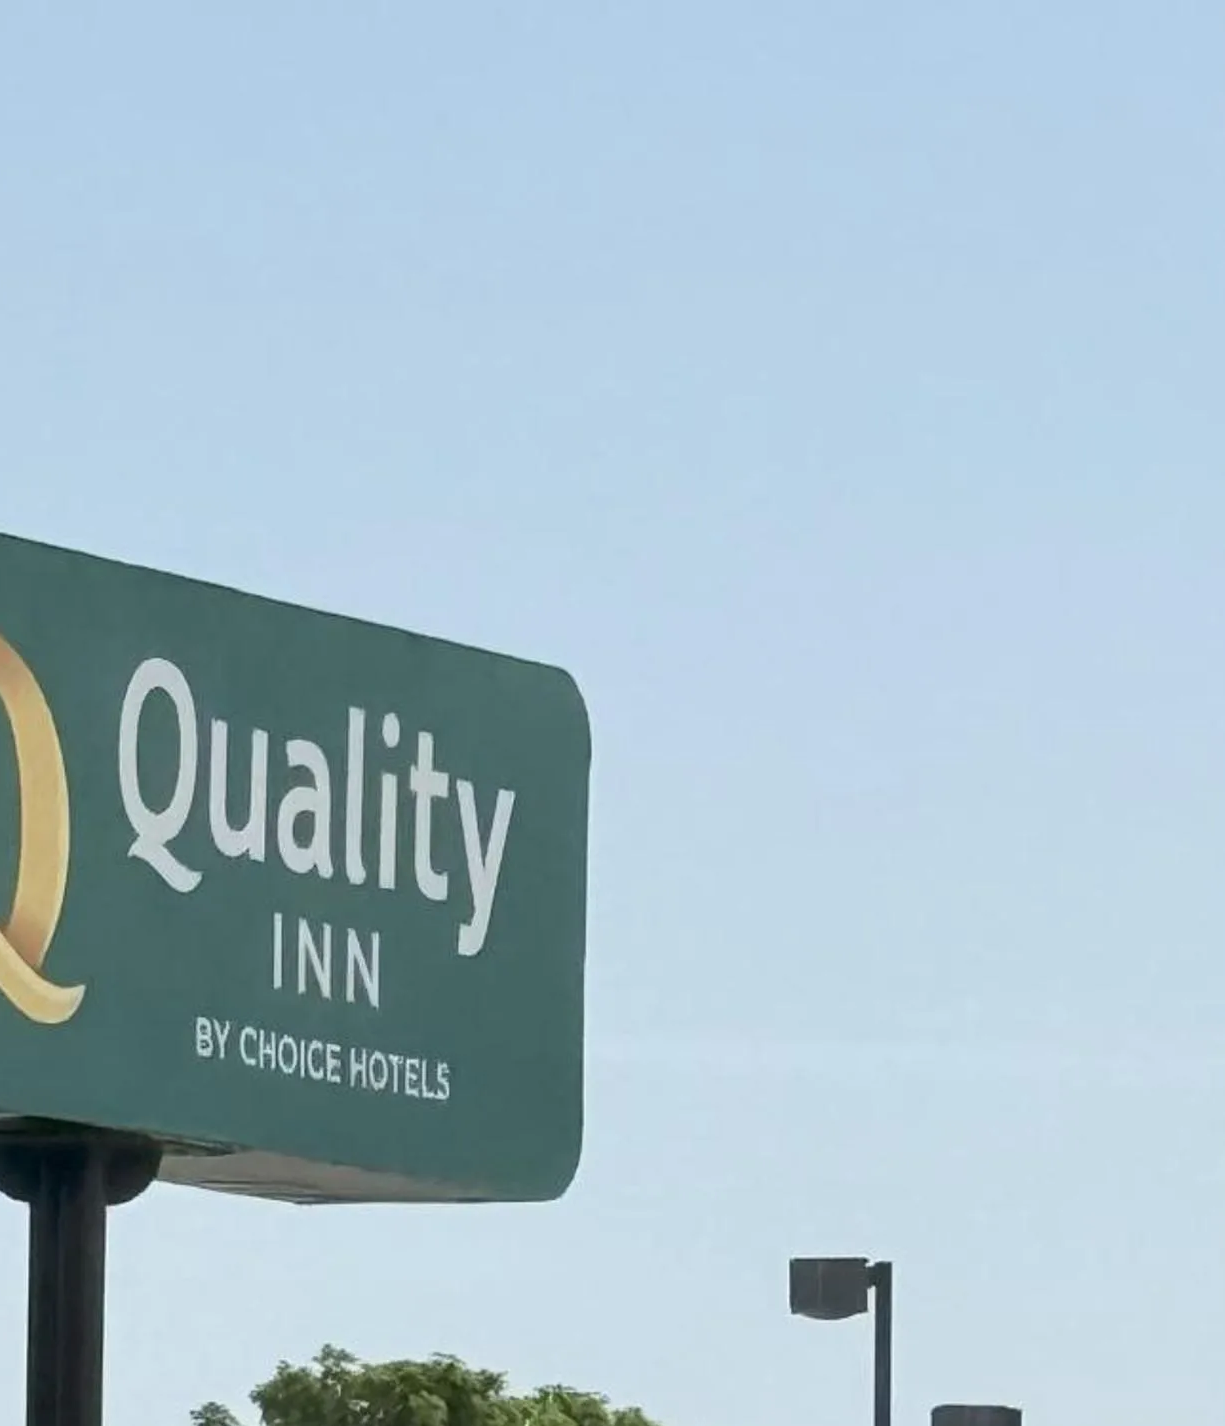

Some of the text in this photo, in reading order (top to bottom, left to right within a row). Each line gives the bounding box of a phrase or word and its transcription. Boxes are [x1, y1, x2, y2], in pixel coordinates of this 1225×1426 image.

[118, 656, 516, 957] Quality
[272, 912, 381, 1008] INN
[195, 1016, 451, 1101] BY CHOICE HOTELS
